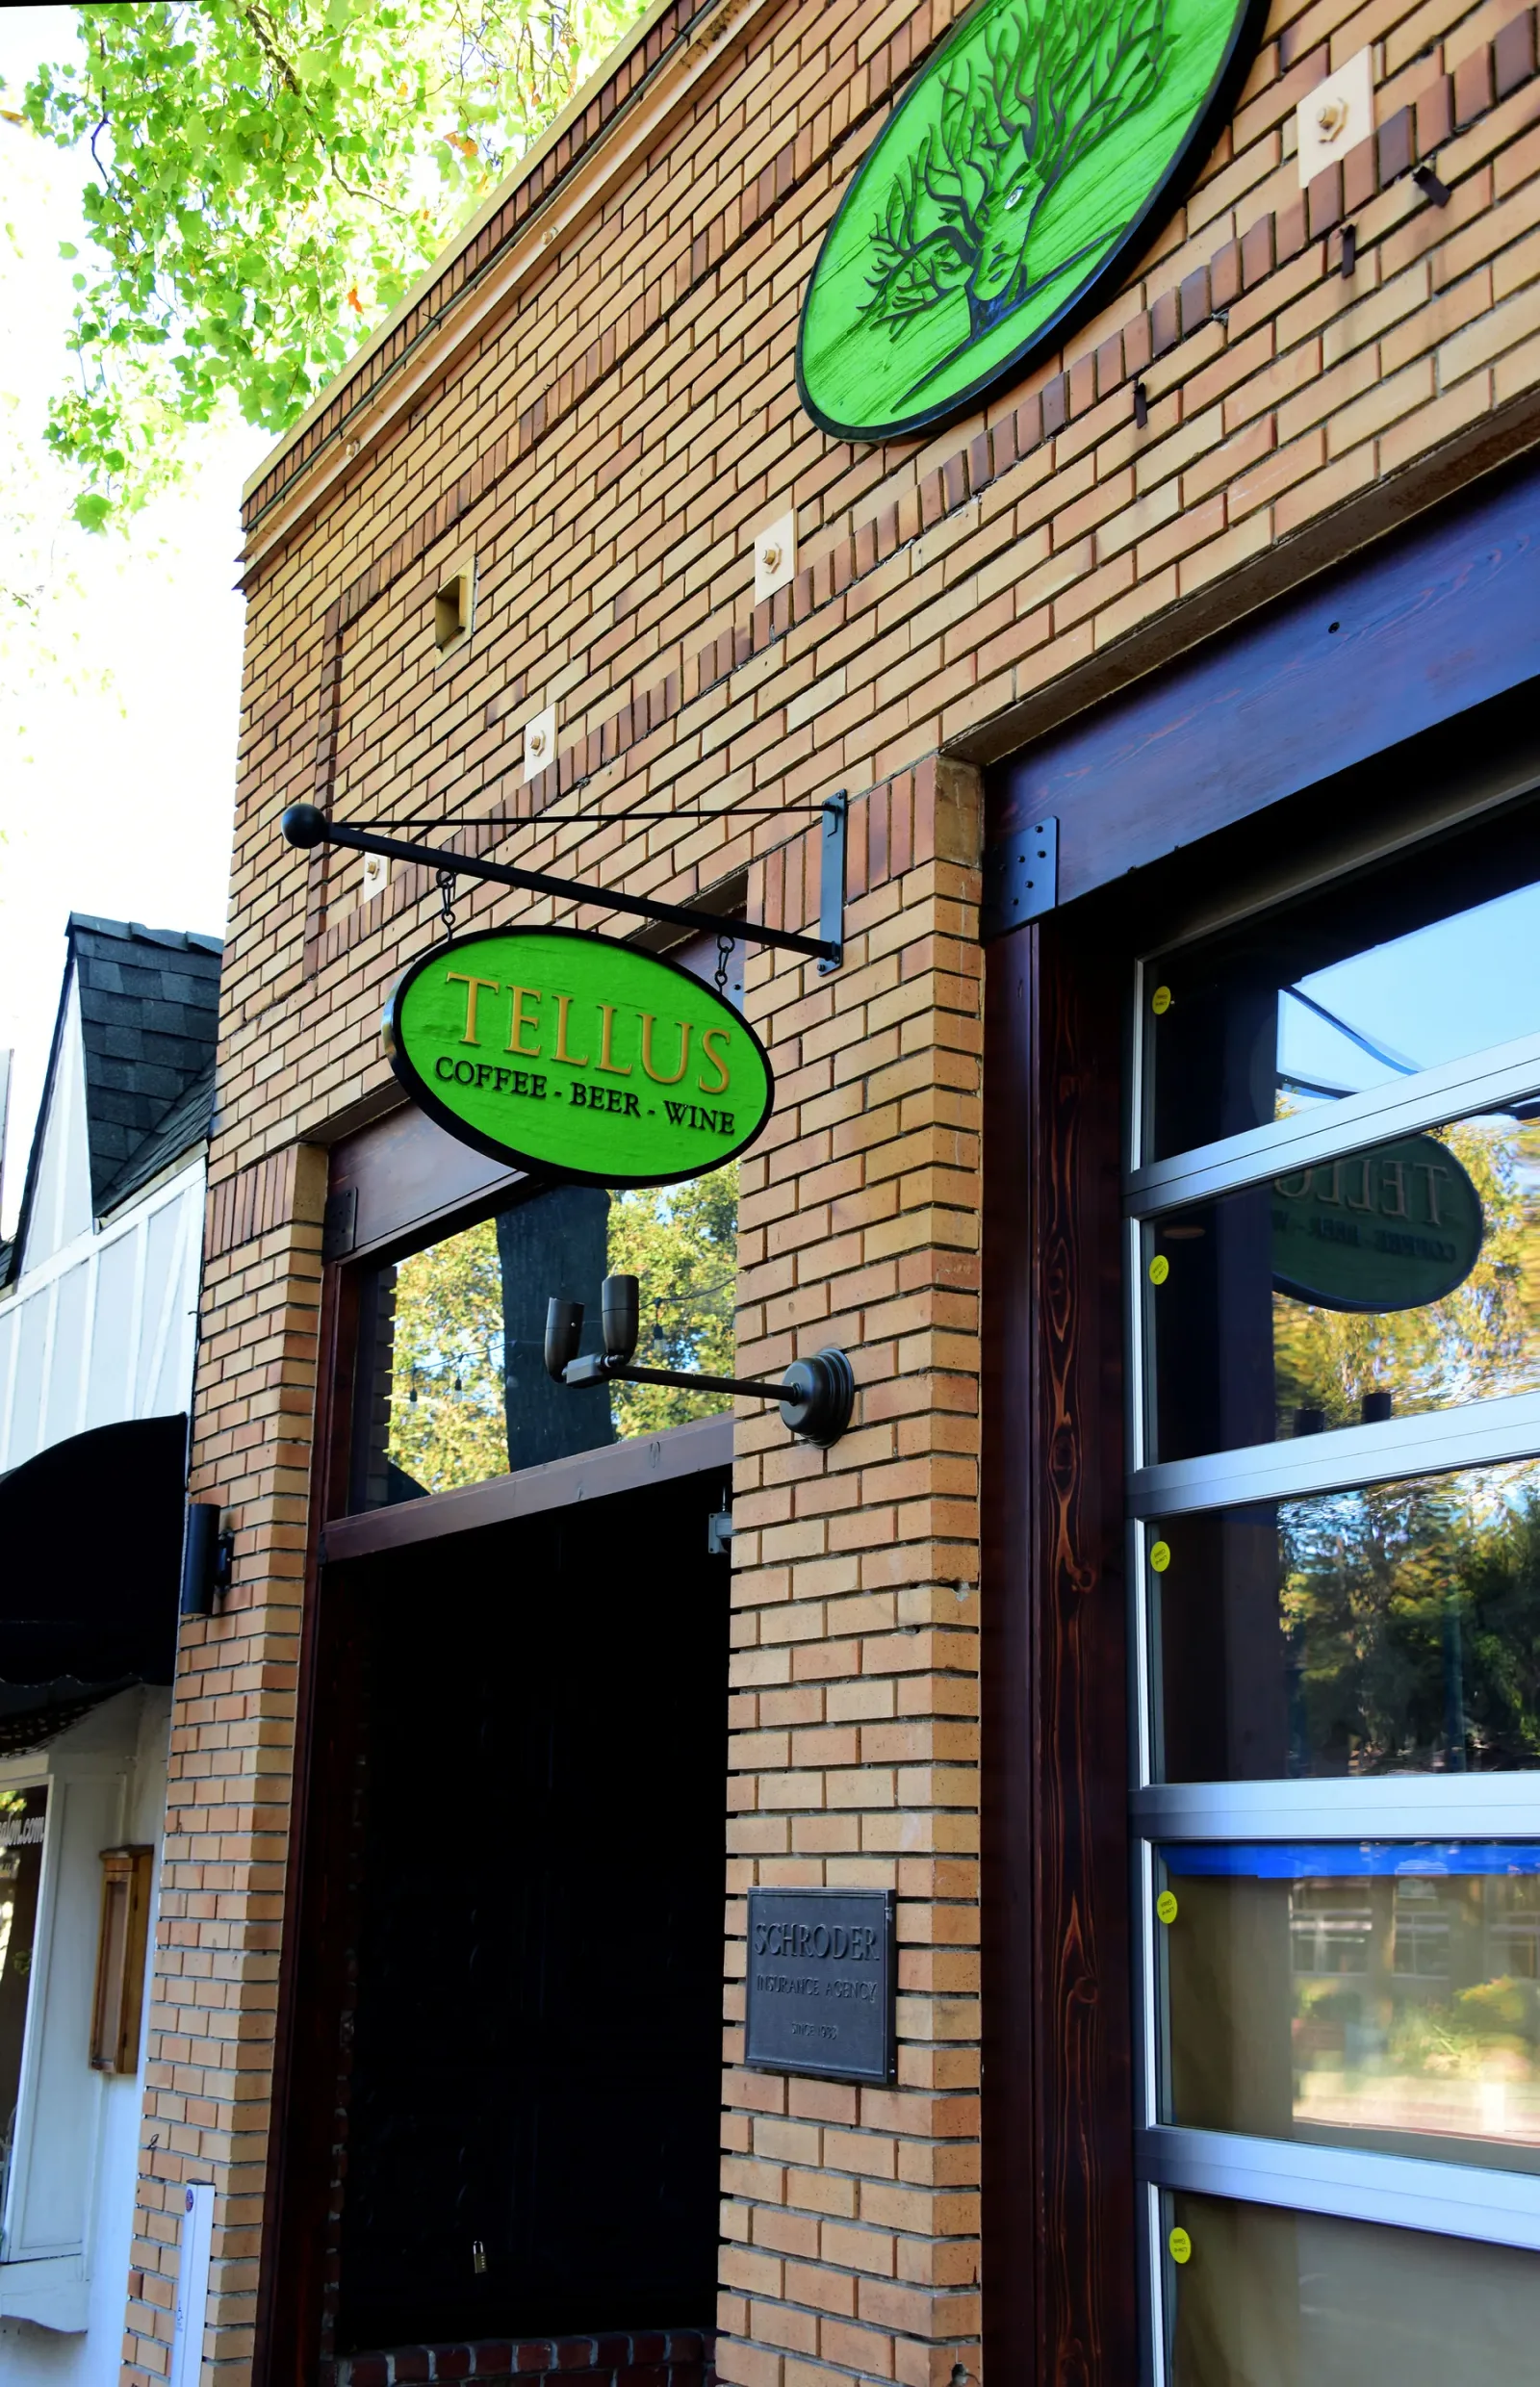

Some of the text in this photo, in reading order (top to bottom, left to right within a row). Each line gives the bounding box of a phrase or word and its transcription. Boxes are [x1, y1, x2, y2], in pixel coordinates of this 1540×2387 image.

[446, 971, 731, 1094] TELLUS
[435, 1056, 547, 1099] COFFEE
[570, 1082, 642, 1118] BEER
[663, 1100, 735, 1136] WINE
[754, 1922, 881, 1961] SCHRODER
[757, 1974, 878, 2002] INSURANCE AGENCY
